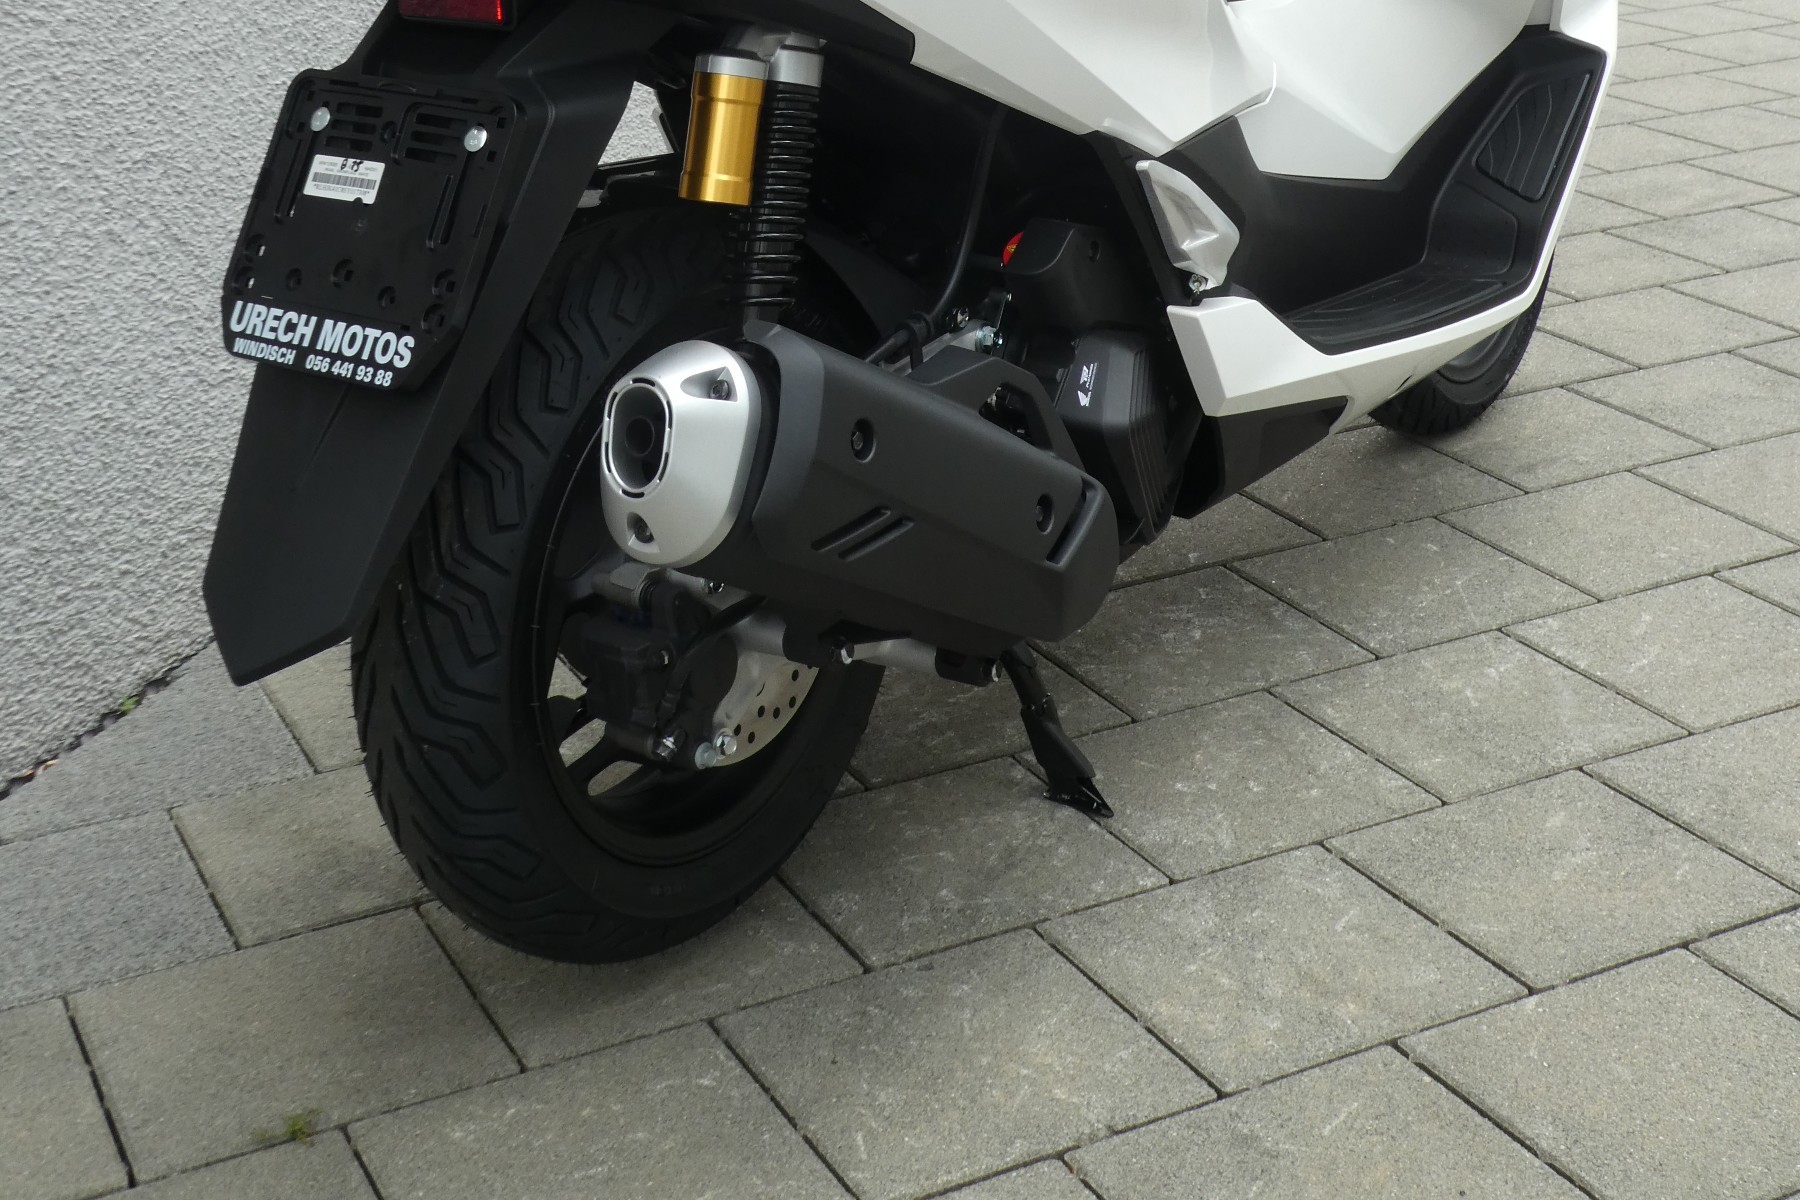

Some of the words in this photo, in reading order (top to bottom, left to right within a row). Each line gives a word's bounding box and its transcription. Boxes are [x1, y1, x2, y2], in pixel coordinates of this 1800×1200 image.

[229, 300, 318, 347] URECH
[315, 318, 415, 369] MOTOS
[233, 337, 297, 365] WINDISCH
[305, 354, 329, 373] 056
[331, 360, 354, 378] 441
[355, 365, 373, 382] 93
[374, 371, 393, 387] 88
